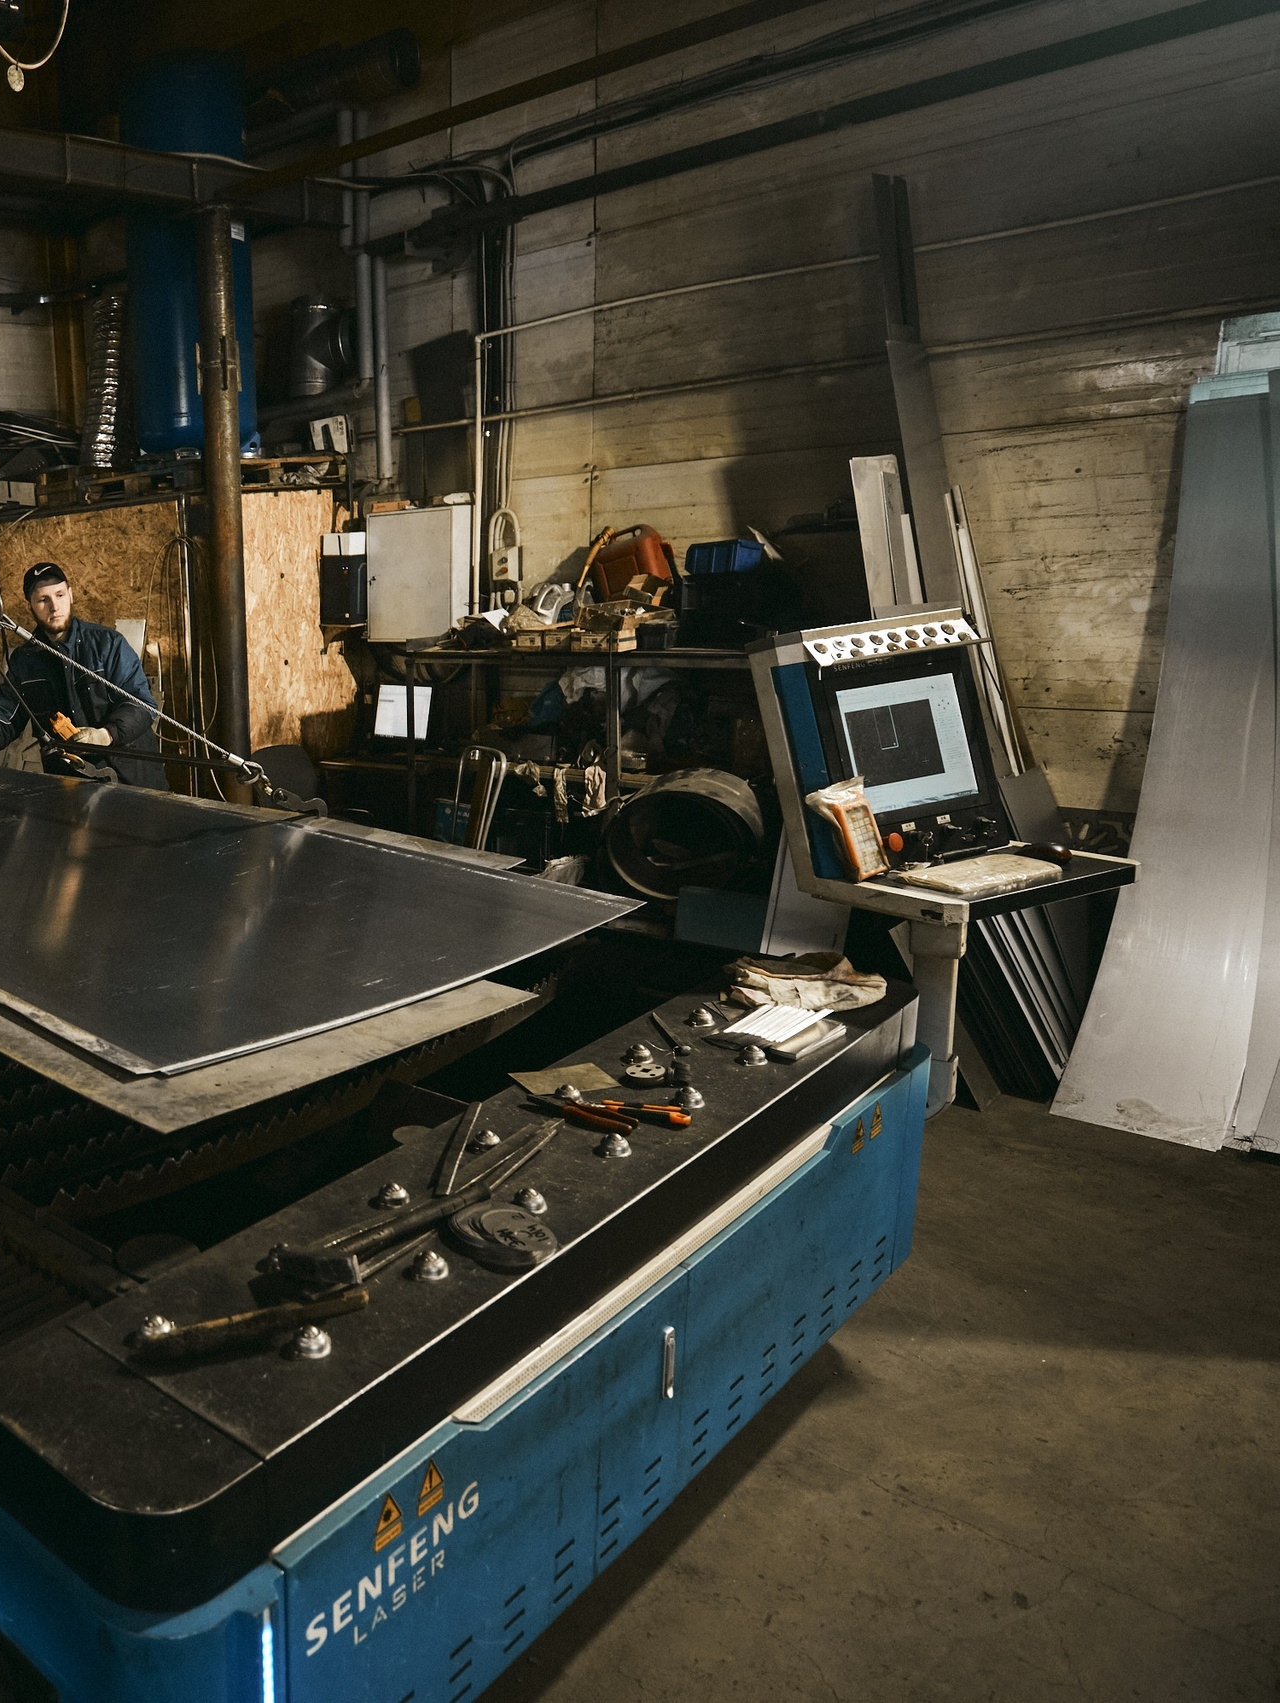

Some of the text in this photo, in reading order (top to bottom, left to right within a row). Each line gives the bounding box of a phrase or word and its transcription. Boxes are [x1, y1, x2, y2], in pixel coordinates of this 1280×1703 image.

[833, 661, 866, 672] SENFENG
[305, 1481, 480, 1658] SENFENG
[353, 1549, 446, 1646] LASER
